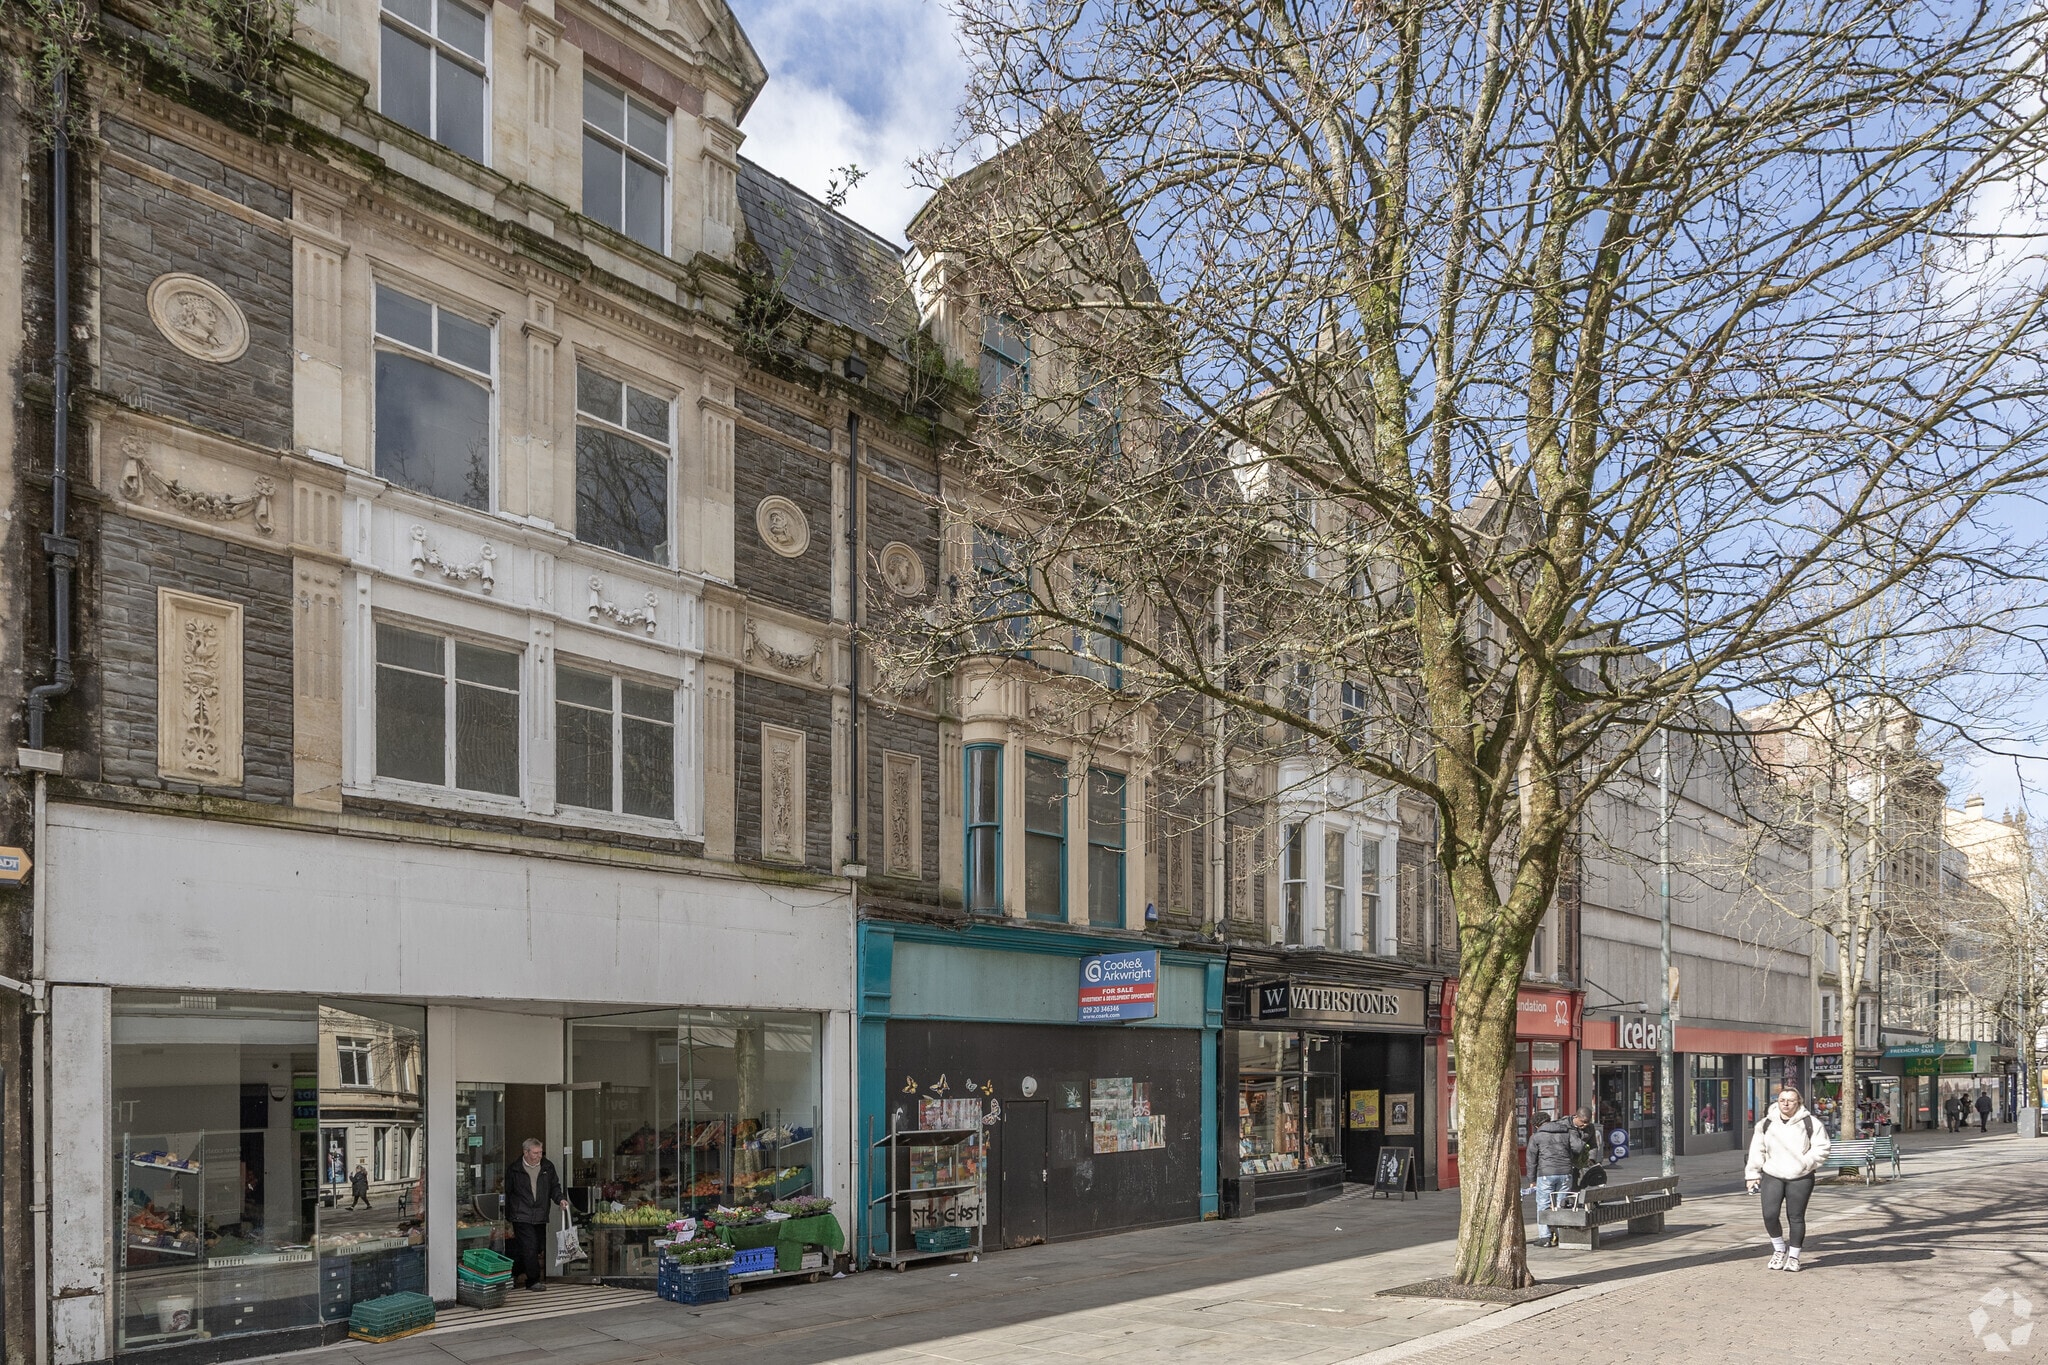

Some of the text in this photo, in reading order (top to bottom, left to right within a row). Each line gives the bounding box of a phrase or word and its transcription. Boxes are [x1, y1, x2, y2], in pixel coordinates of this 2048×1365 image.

[1104, 958, 1142, 970] Cooke&
[1104, 968, 1151, 981] Arkwright
[1265, 988, 1285, 1007] W
